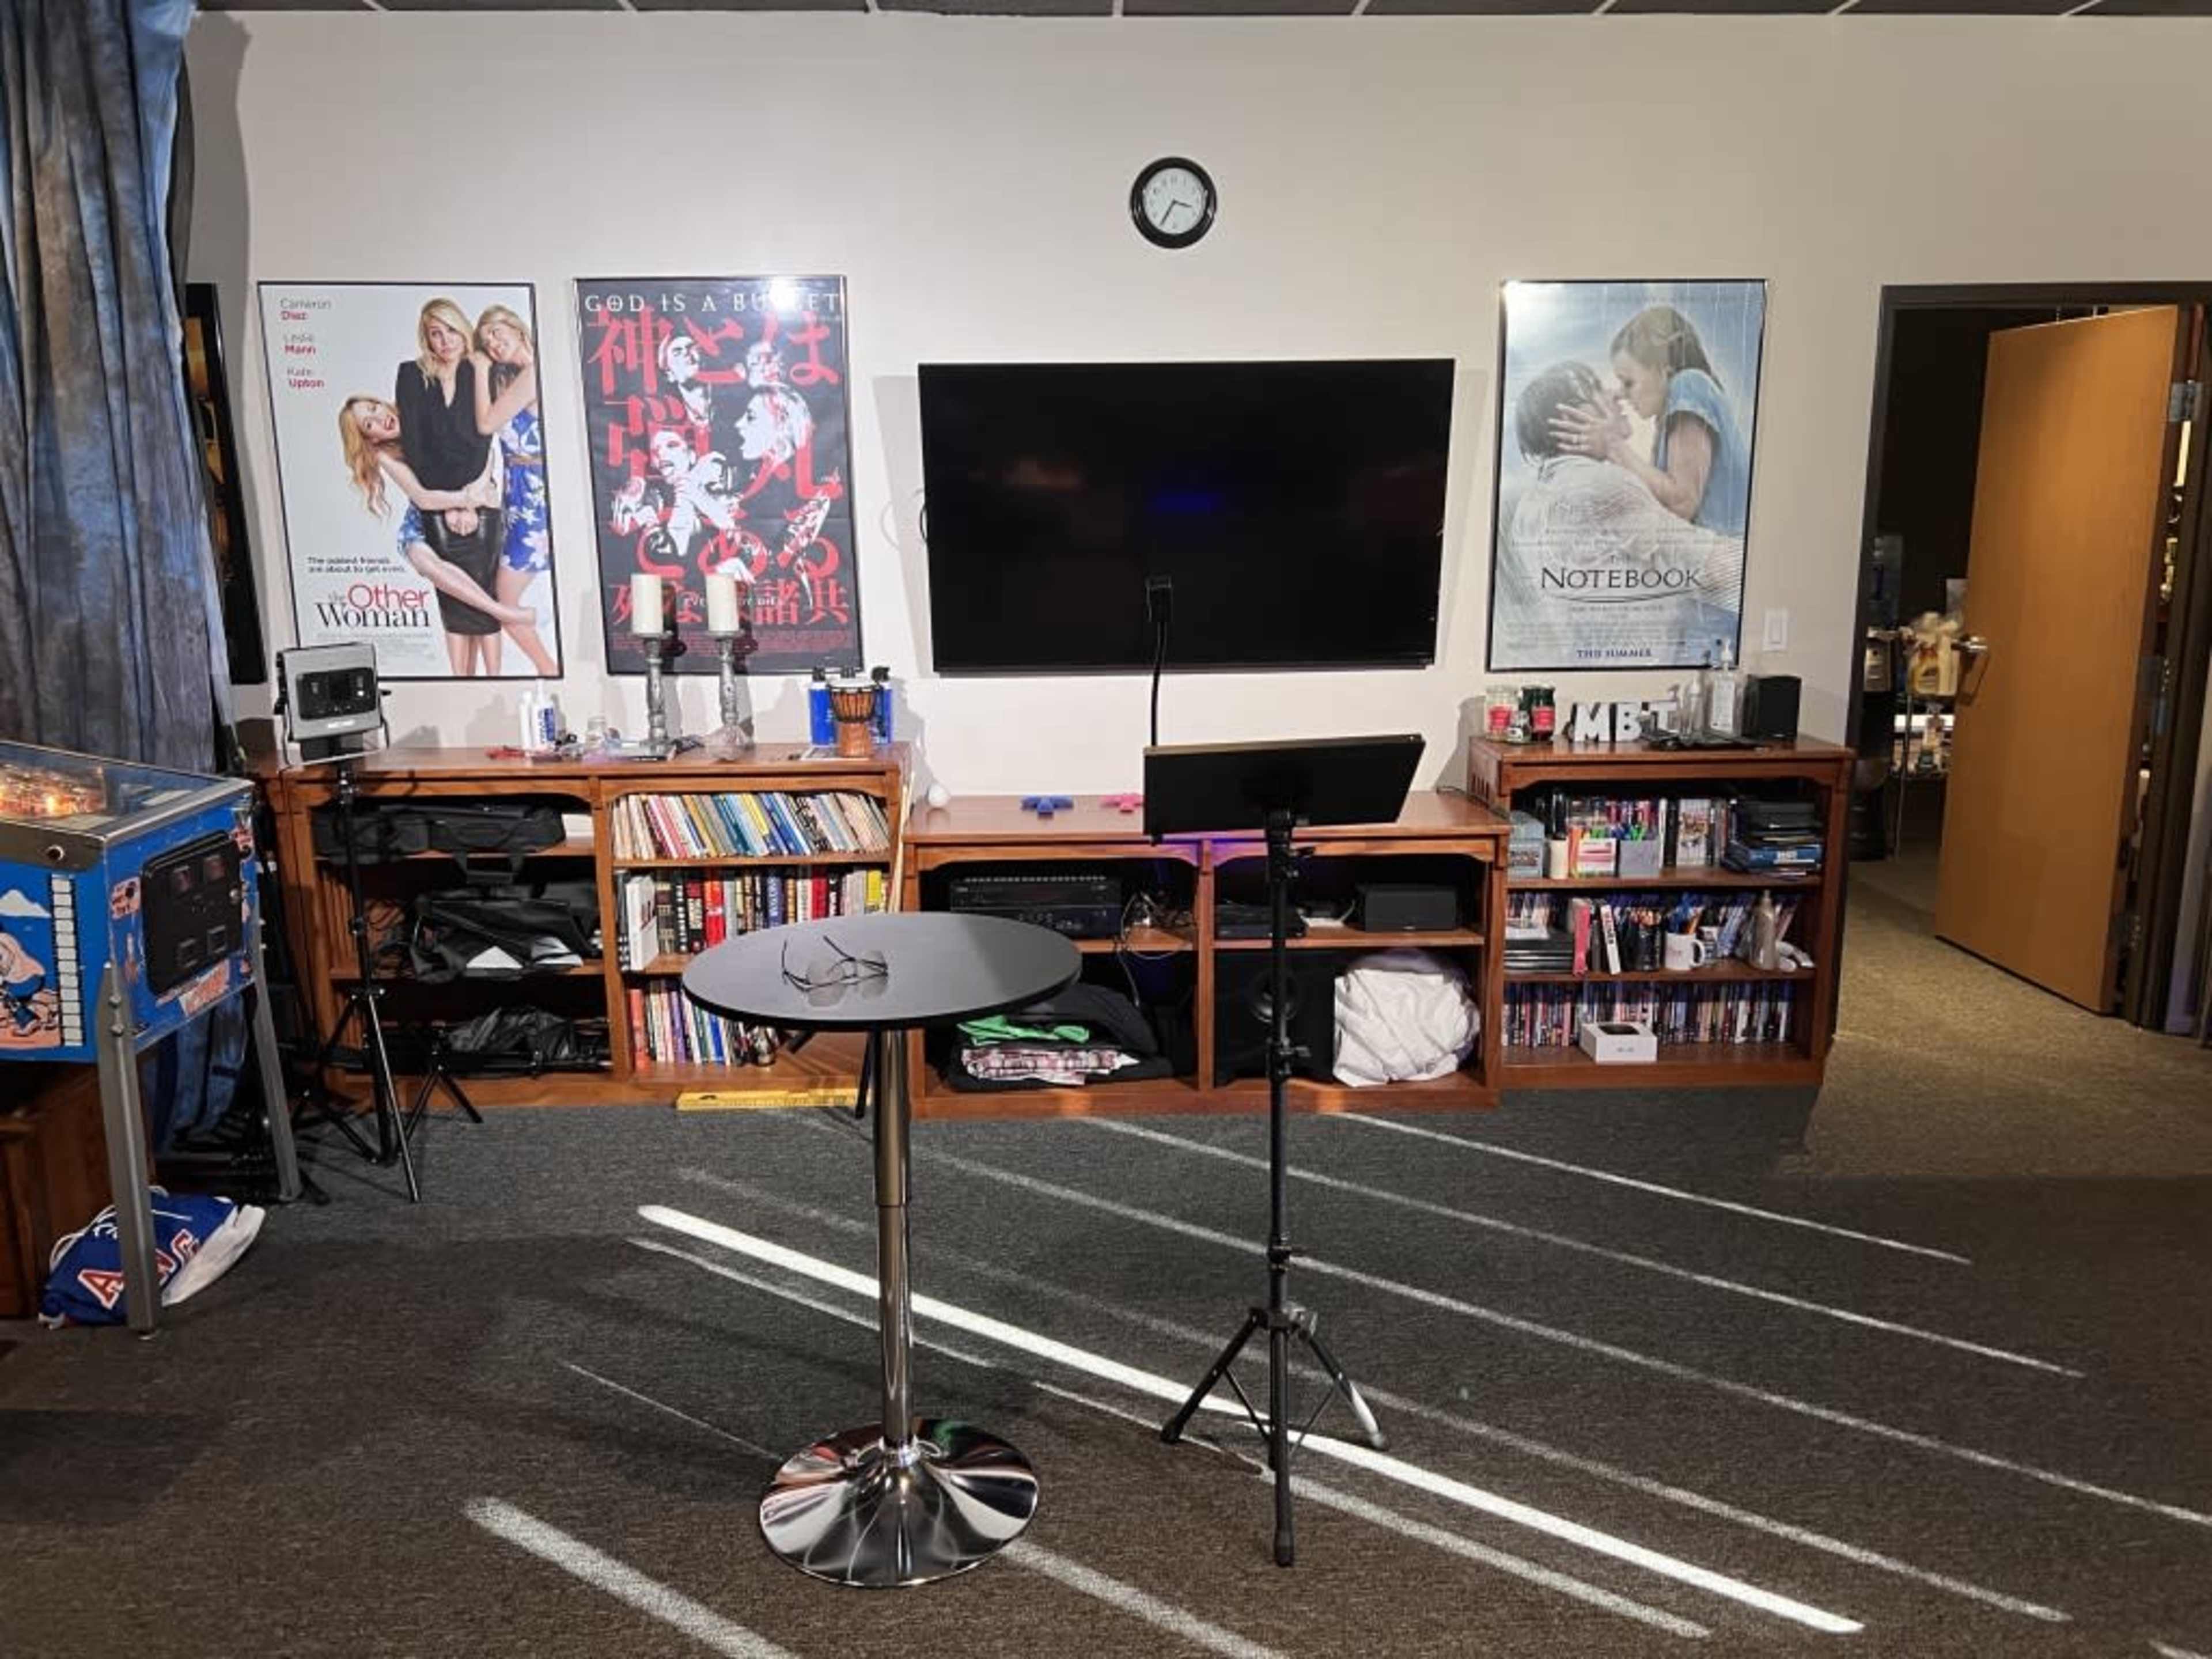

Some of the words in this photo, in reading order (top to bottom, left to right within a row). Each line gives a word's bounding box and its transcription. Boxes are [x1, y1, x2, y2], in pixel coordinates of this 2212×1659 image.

[585, 294, 645, 312] GOD
[662, 293, 686, 312] IS
[701, 294, 718, 312] A
[733, 293, 839, 312] BUET
[289, 378, 325, 389] Upton
[1540, 566, 1704, 589] NOTEBOOK
[348, 583, 431, 610] Other
[315, 602, 431, 628] Woman
